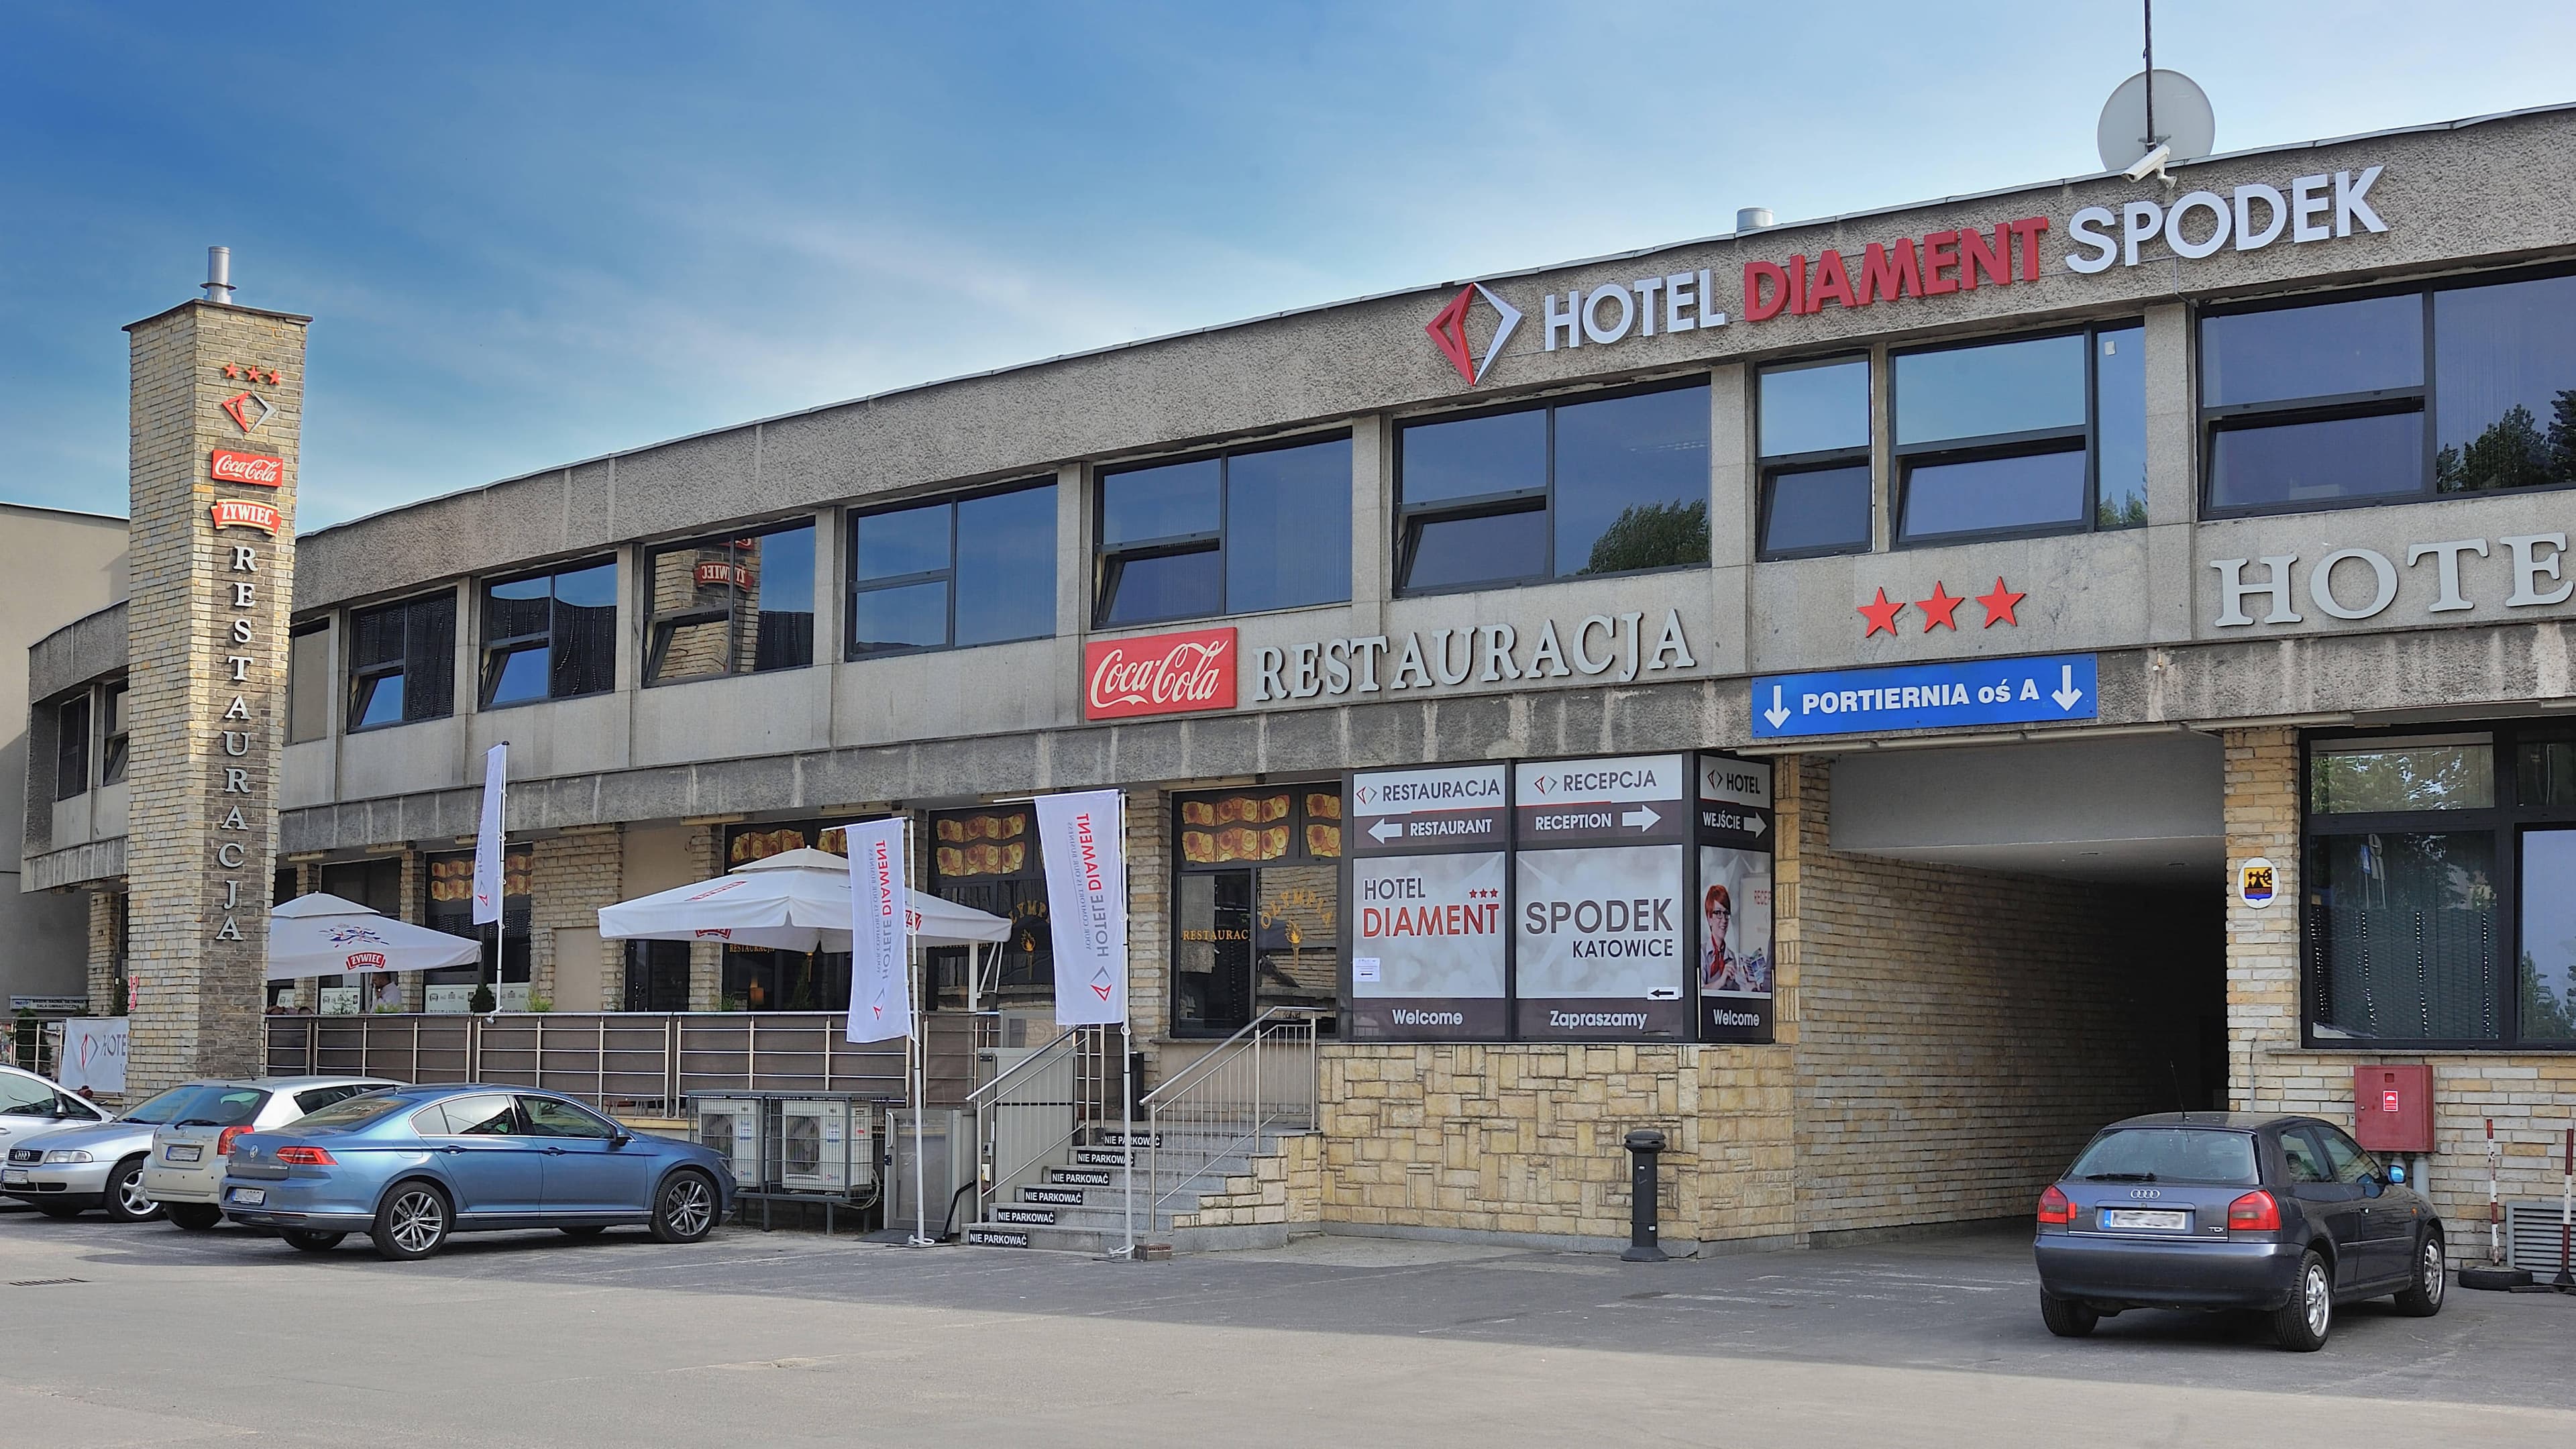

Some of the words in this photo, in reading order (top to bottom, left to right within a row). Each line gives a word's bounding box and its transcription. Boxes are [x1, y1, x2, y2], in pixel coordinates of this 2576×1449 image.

[1544, 269, 1729, 352] HOTEL
[1744, 216, 2049, 322] DIAMENT
[2064, 164, 2390, 274] SPODEK
[215, 454, 280, 482] Coca-Cola
[221, 501, 274, 525] ŻYWIEC
[2210, 532, 2575, 627] HOTE
[1252, 608, 1696, 702] RESTAURACJA
[1090, 639, 1228, 709] Coca-Cola
[1801, 683, 1969, 716] PORTIERNIA
[1978, 678, 2010, 702] oś
[2019, 679, 2040, 701] A
[215, 545, 258, 941] RESTAURACJA
[1382, 778, 1501, 802] RESTAURACJA
[1563, 769, 1656, 792] RECEPCJA
[1727, 773, 1760, 794] HOTEL
[1409, 818, 1492, 837] RESTAURANT
[1535, 813, 1612, 831] RECEPTION
[1703, 810, 1741, 830] WEJŚCIE
[1364, 877, 1426, 900] HOTEL
[1261, 888, 1333, 929] OLYMPIA
[1525, 898, 1673, 935] SPODEK
[1363, 904, 1500, 938] DIAMENT
[1183, 929, 1250, 941] RESTAURAC
[1572, 938, 1674, 959] KATOWICE
[1391, 1009, 1464, 1025] Welcome
[1550, 1011, 1647, 1030] Zapraszamy
[1713, 1009, 1760, 1026] Welcome
[100, 1033, 126, 1057] HOTE
[1104, 1136, 1116, 1144] NIE
[1118, 1135, 1160, 1146] PKOWĆ
[1077, 1153, 1089, 1163] NIE
[1052, 1173, 1065, 1183] NIE
[1066, 1173, 1109, 1185] PARKOWAĆ
[1025, 1191, 1038, 1201] NIE
[1039, 1191, 1081, 1204] PARKOWAĆ
[998, 1211, 1010, 1221] NIE
[1012, 1211, 1055, 1223] PARKOWAĆ
[969, 1233, 982, 1244] NIE
[984, 1233, 1027, 1246] PARKOWAĆ
